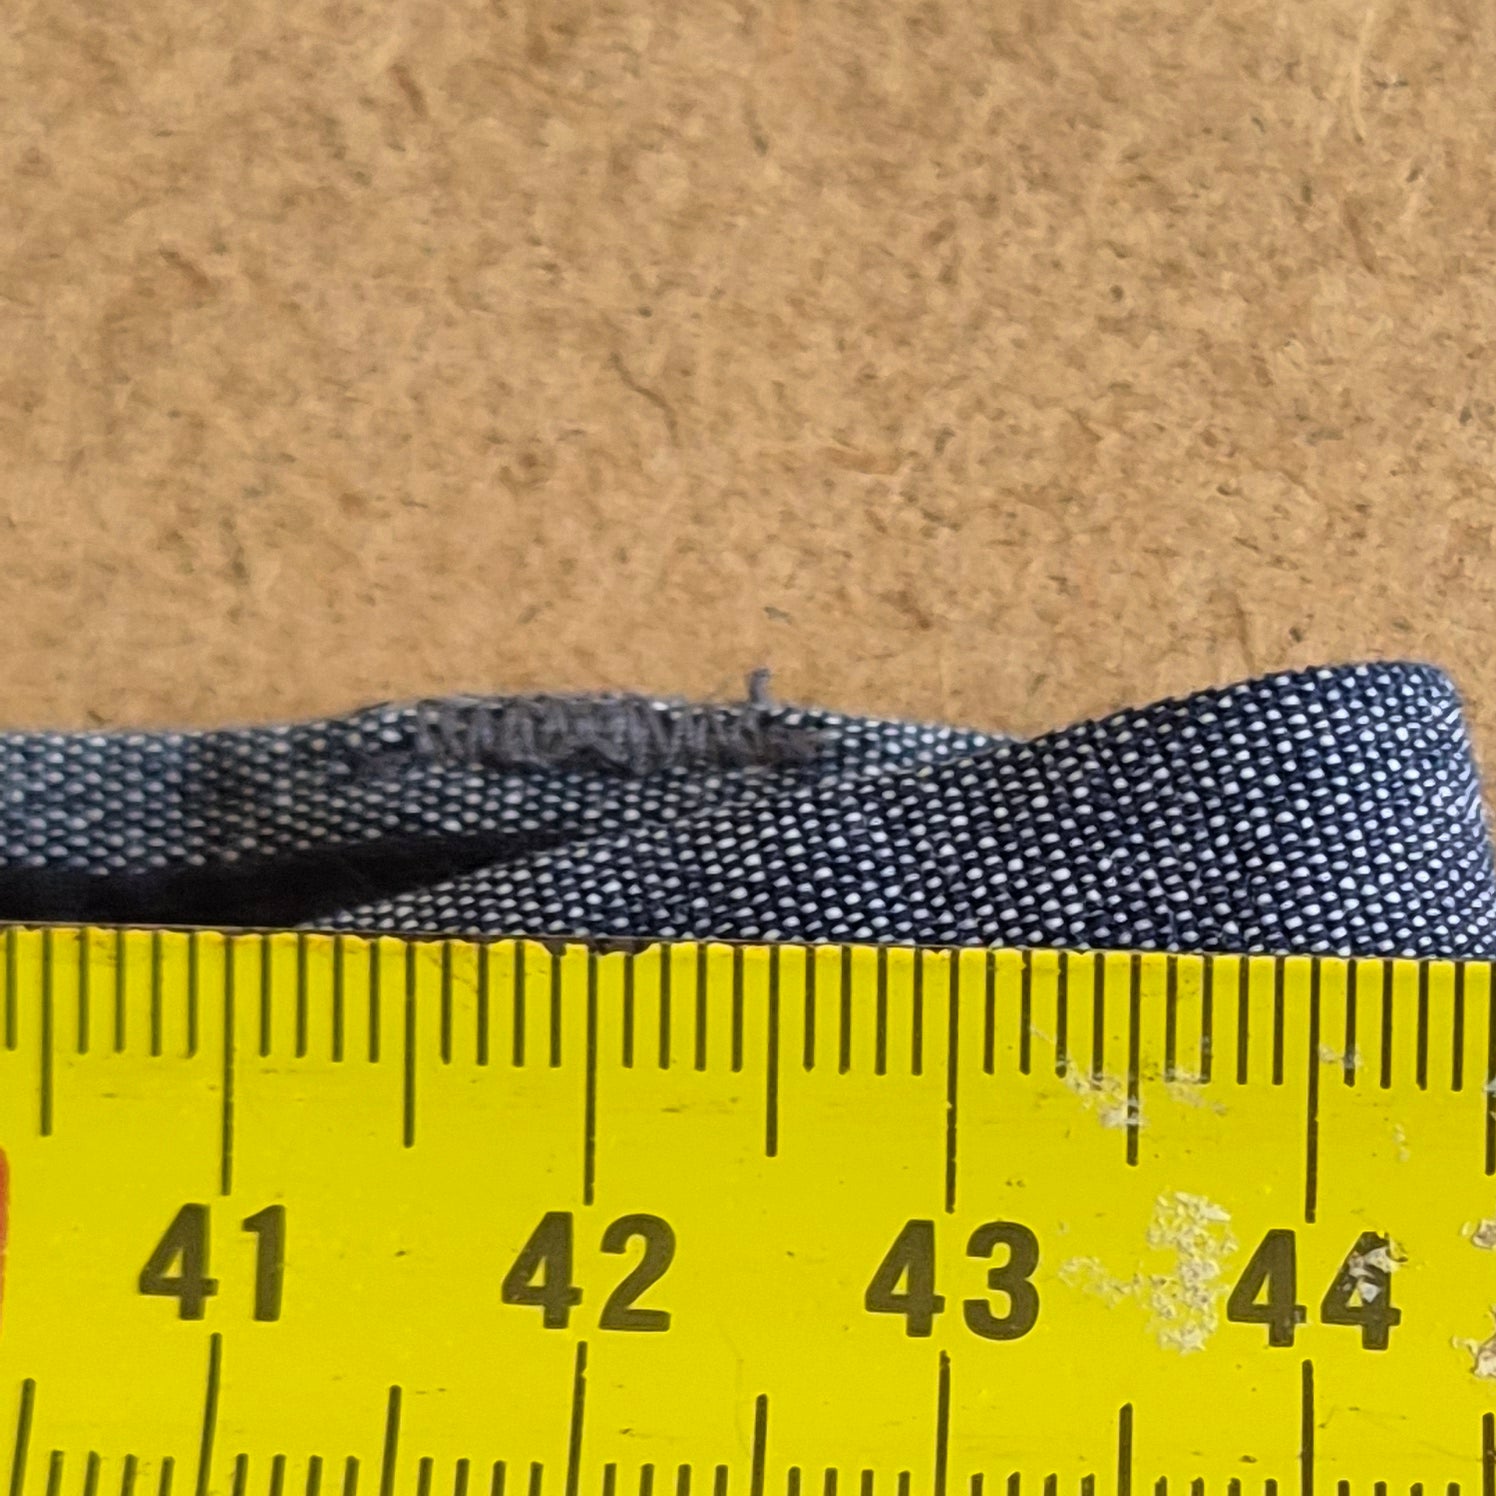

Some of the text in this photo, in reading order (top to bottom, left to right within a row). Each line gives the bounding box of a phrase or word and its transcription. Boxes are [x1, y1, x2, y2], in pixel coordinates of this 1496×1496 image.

[138, 1203, 284, 1322] 41
[502, 1211, 675, 1333] 42
[865, 1219, 1040, 1341] 43
[1226, 1229, 1402, 1351] 44
